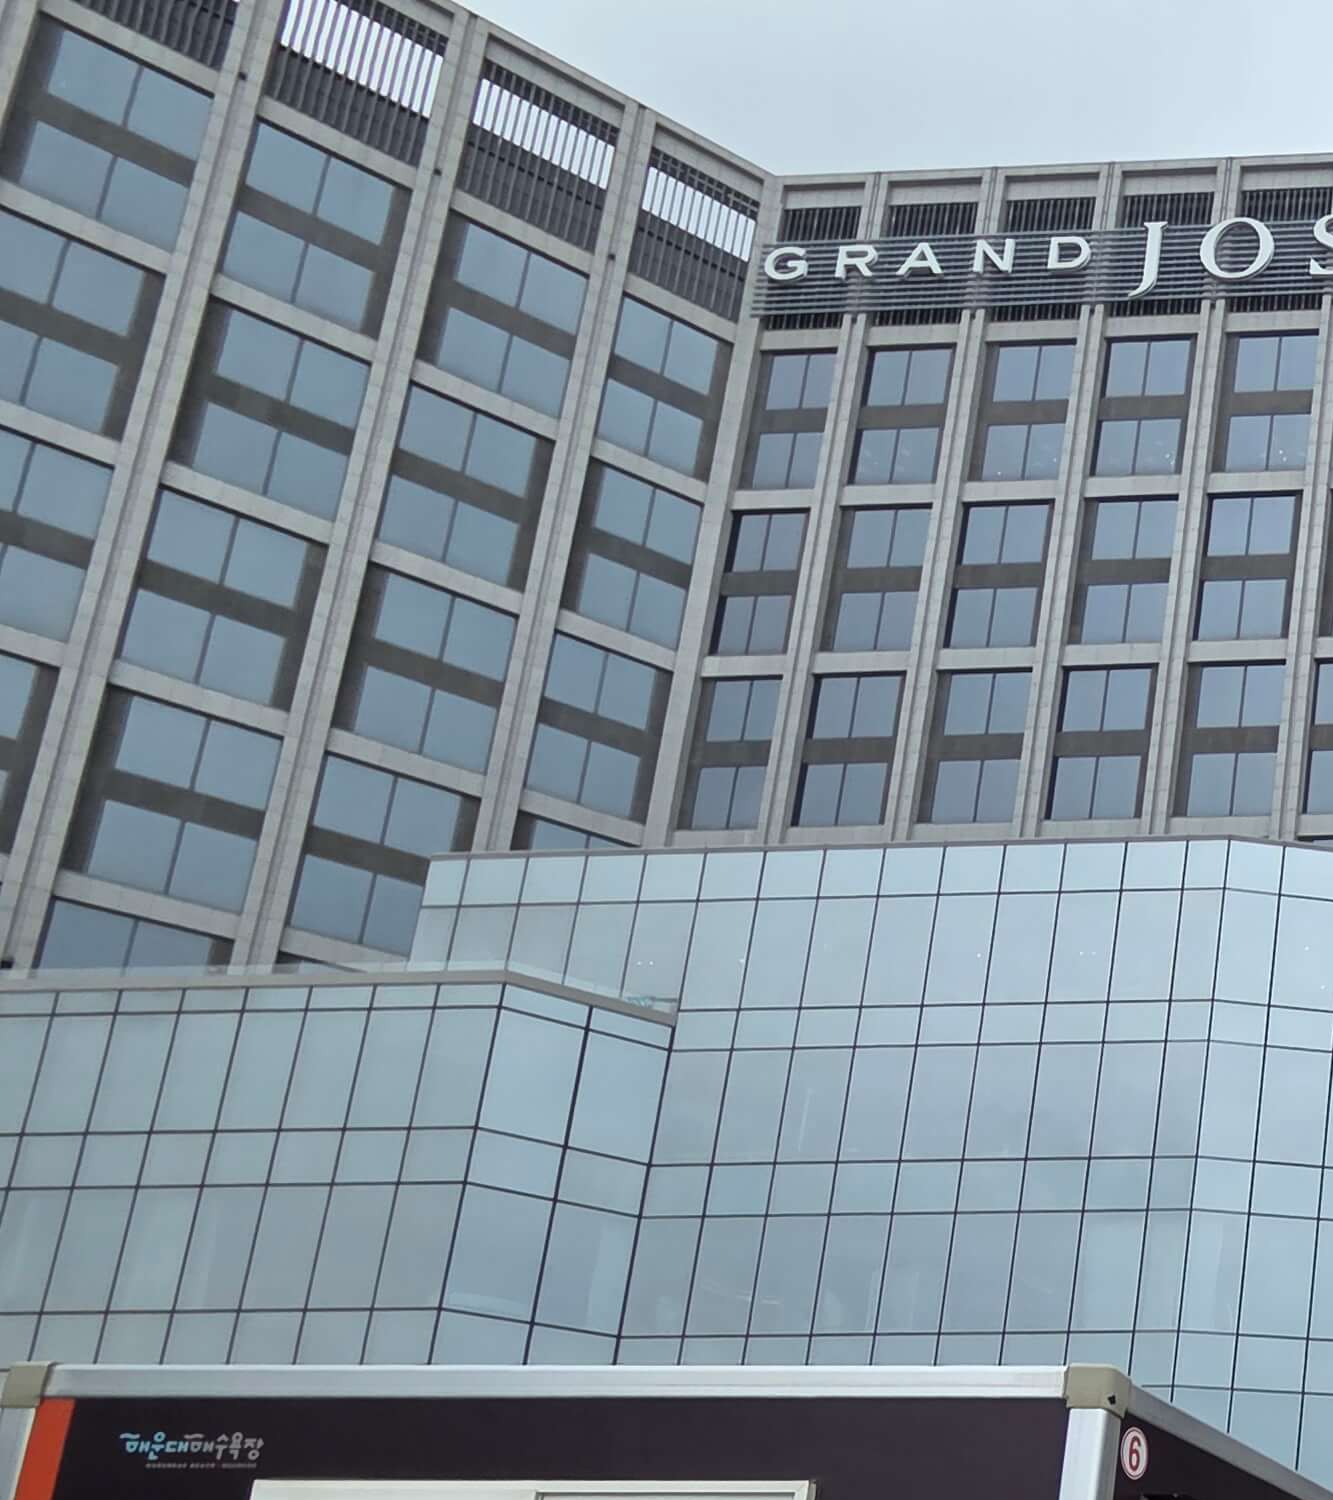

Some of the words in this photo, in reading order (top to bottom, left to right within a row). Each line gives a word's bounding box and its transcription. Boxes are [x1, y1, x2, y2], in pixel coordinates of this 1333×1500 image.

[763, 235, 1093, 282] GRAND
[119, 1431, 265, 1461] 해운대해수욕장
[1128, 1435, 1142, 1472] 6
